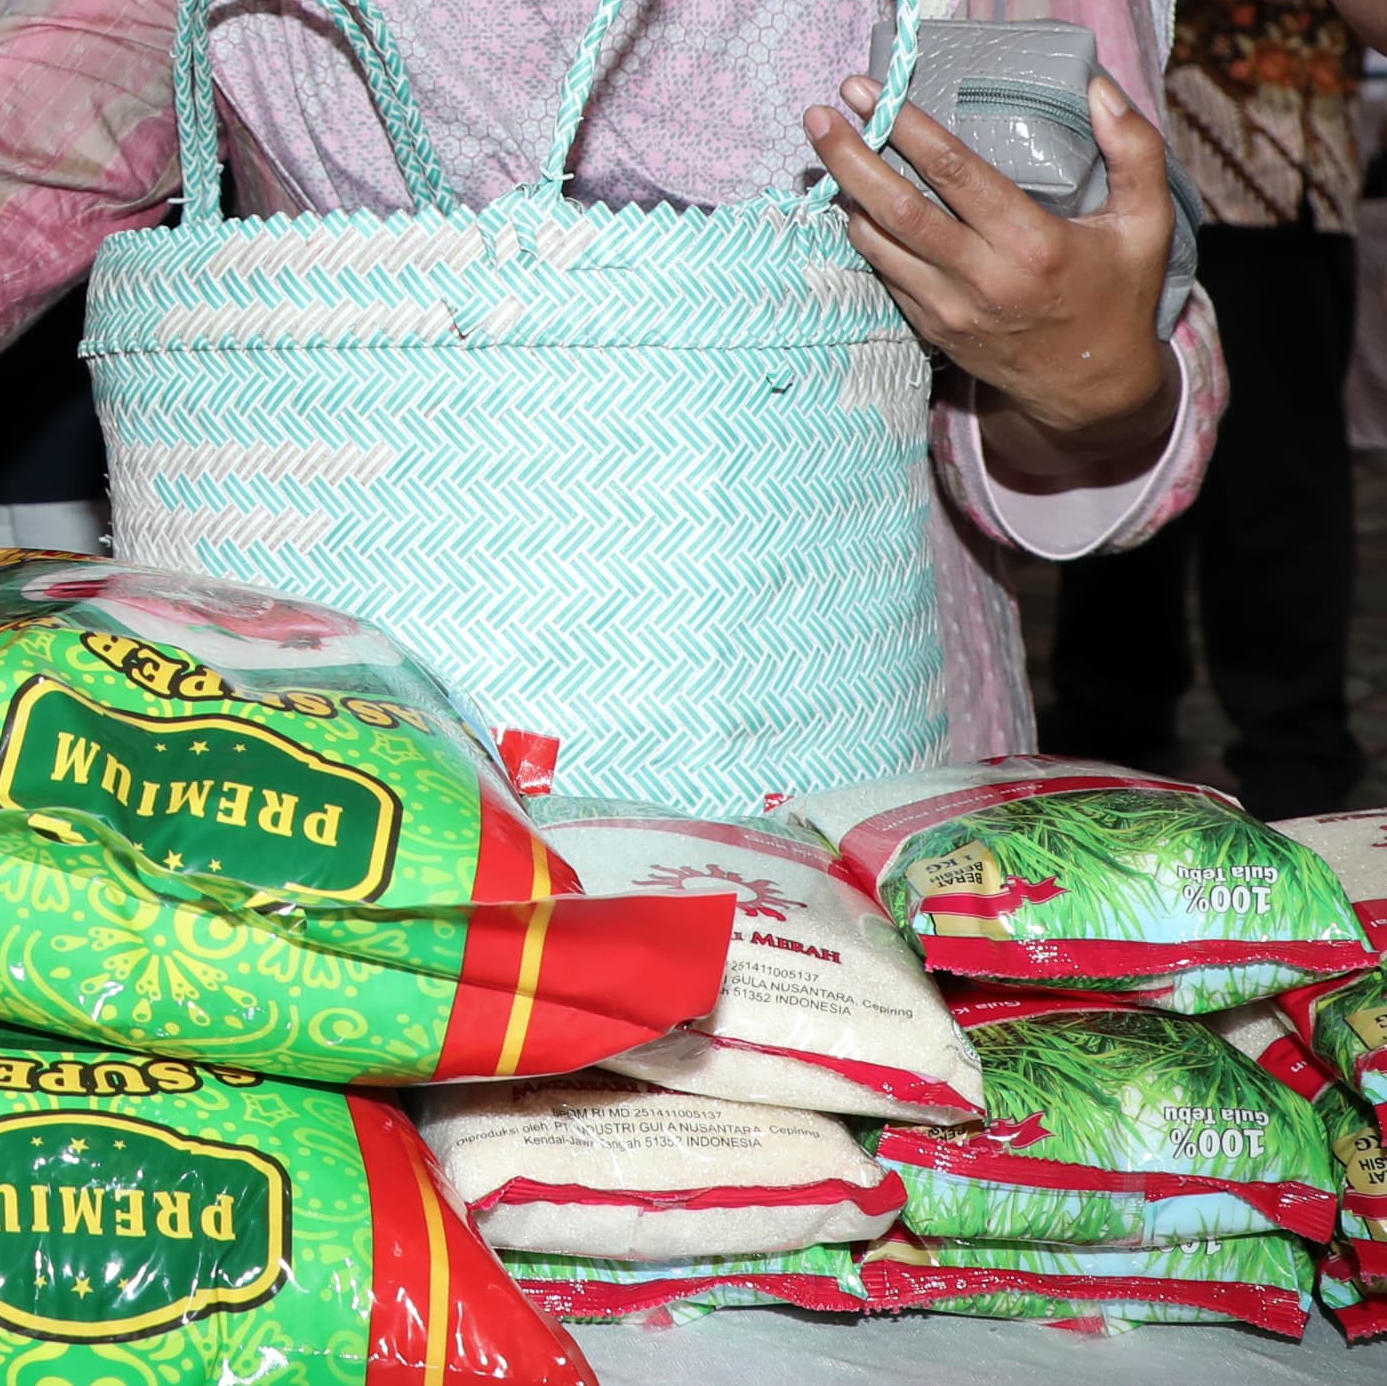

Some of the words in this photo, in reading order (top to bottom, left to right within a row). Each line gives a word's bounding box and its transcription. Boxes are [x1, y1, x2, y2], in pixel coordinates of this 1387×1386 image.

[49, 728, 345, 850] PREMIUM
[926, 859, 958, 874] KG
[1177, 865, 1226, 883] Tebu
[1231, 865, 1279, 884] Gula
[938, 873, 983, 888] BERAT
[1183, 885, 1272, 914] 100%
[750, 931, 842, 964] MERAH
[730, 960, 820, 982] 251411005137
[732, 975, 768, 990] GULA
[862, 999, 914, 1018] Cepiring
[733, 989, 771, 1003] 51352
[775, 994, 852, 1016] INDONESIA
[975, 998, 1022, 1011] Gula
[592, 1107, 605, 1117] RI
[609, 1108, 631, 1117] MD
[635, 1107, 722, 1120] 251411005137
[1164, 1107, 1216, 1125] Tebu
[1220, 1108, 1269, 1126] Gula
[456, 1126, 519, 1147] Diproduksi
[769, 1125, 819, 1139] Cepiring
[686, 1136, 762, 1148] INDONESIA
[1170, 1128, 1265, 1159] 100%
